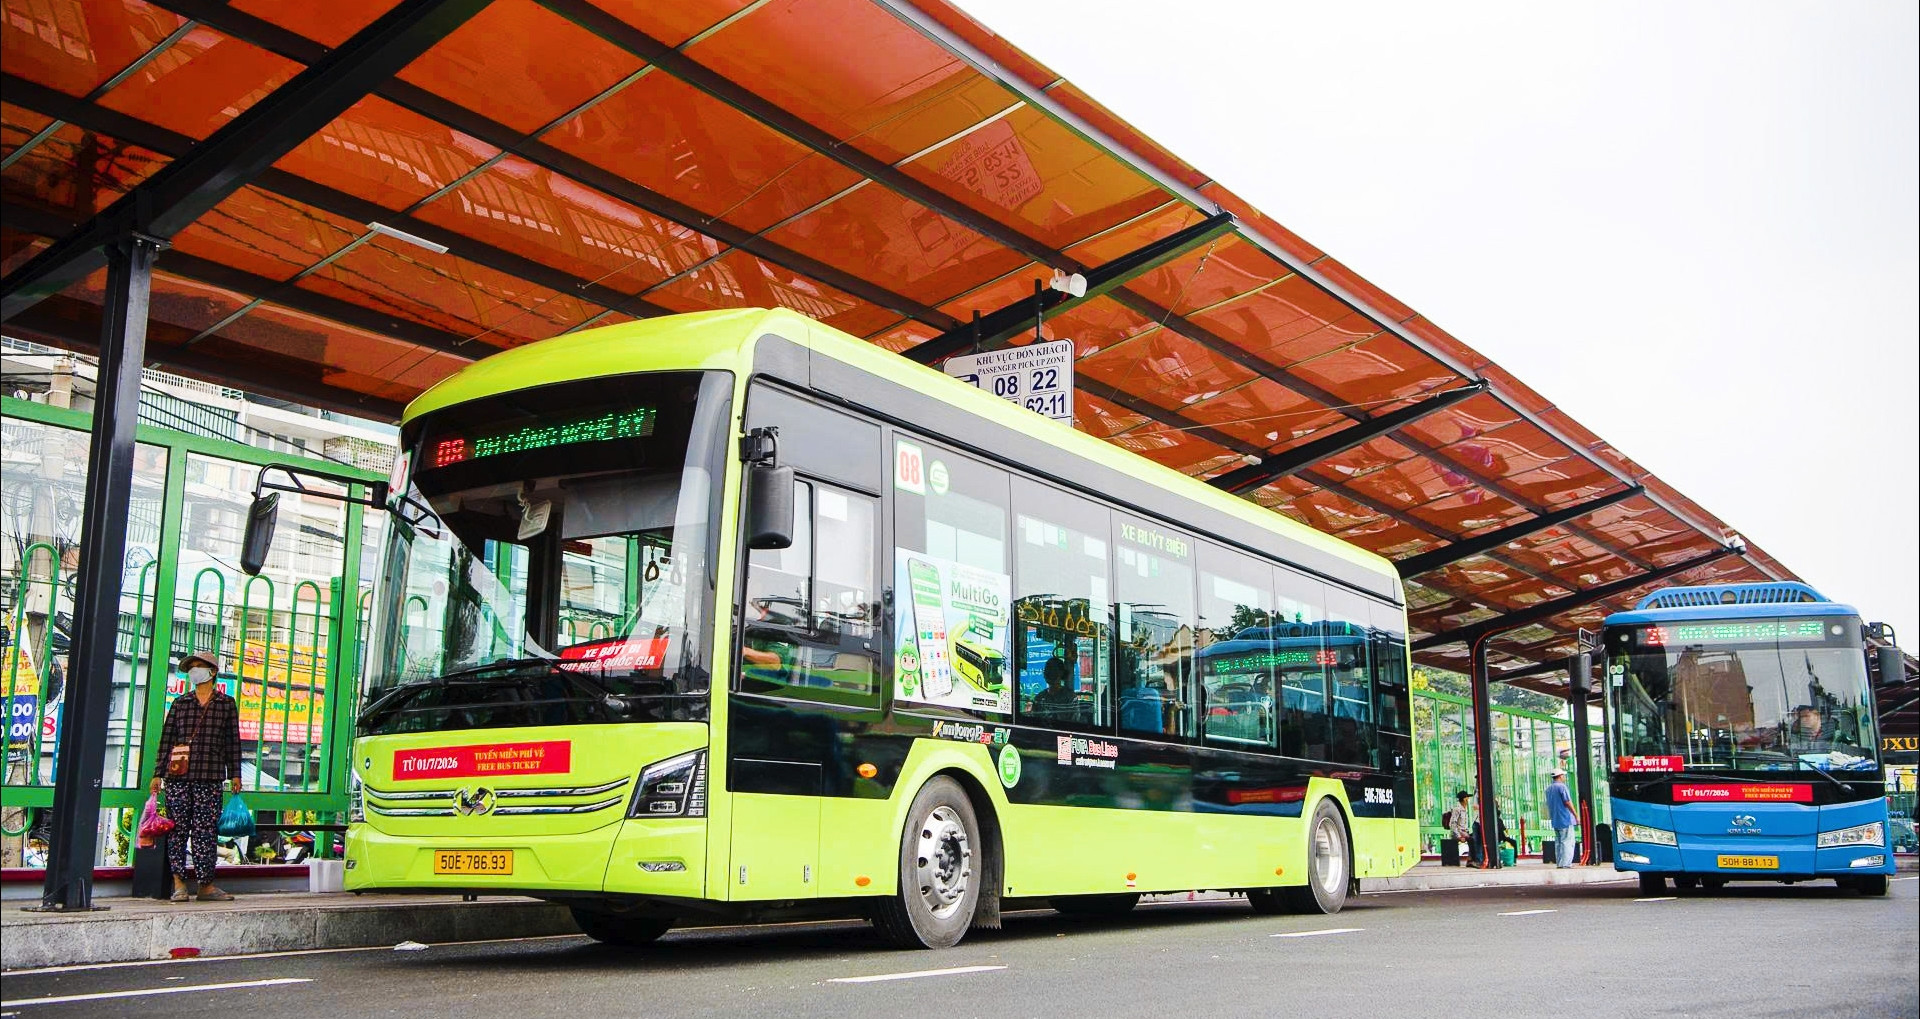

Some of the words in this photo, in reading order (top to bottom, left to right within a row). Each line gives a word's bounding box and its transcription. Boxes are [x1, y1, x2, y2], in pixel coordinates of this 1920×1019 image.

[996, 351, 1015, 365] VỰC
[1016, 347, 1034, 360] ĐÓN
[1036, 344, 1068, 357] KHÁCH
[978, 363, 1017, 376] PASSENGER
[1018, 360, 1035, 370] PICK
[1036, 358, 1046, 367] UP
[1046, 356, 1066, 364] ZONE
[995, 375, 1018, 396] 08
[1032, 369, 1057, 391] 22
[1026, 393, 1065, 416] 62-11
[899, 450, 920, 486] 08
[1121, 523, 1136, 541] XE
[1137, 529, 1165, 550] BUÝT
[951, 581, 999, 607] MultiGo
[635, 656, 656, 666] GIA
[403, 757, 416, 771] TỪ
[416, 757, 458, 770] 01/7/2026
[474, 749, 499, 761] TUYẾN
[500, 748, 518, 760] MIỄN
[519, 747, 533, 759] PHÍ
[534, 747, 545, 758] VÉ
[477, 763, 496, 771] FREE
[497, 762, 512, 771] BUS
[512, 760, 541, 770] TICKET
[1364, 787, 1394, 805] 50E-786.93
[1694, 789, 1730, 797] 01/7/2026
